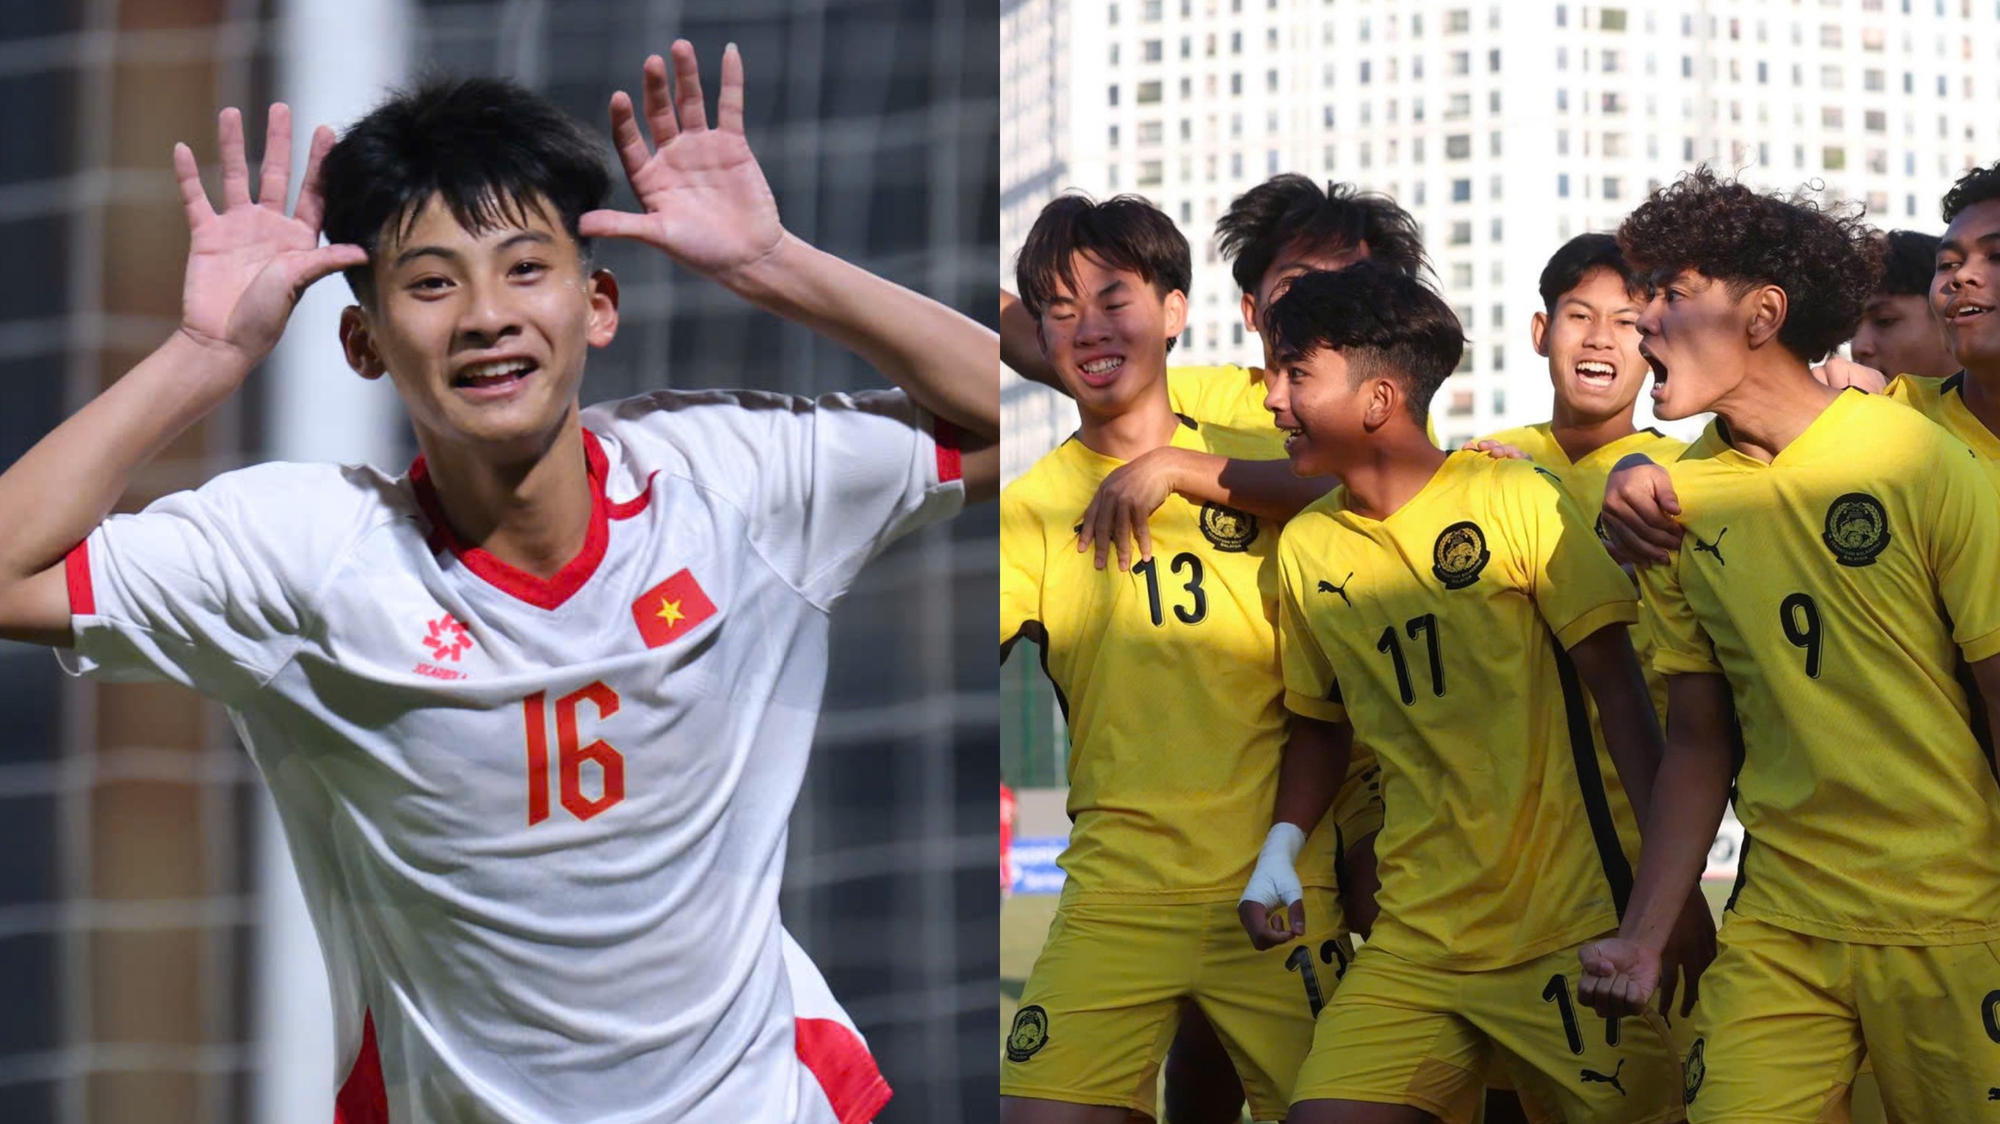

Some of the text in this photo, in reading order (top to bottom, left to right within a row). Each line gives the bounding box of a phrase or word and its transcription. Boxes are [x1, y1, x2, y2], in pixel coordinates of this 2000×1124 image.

[1132, 552, 1209, 627] 13
[1377, 613, 1446, 706] 17
[1779, 592, 1823, 679] 9
[523, 680, 625, 827] 16
